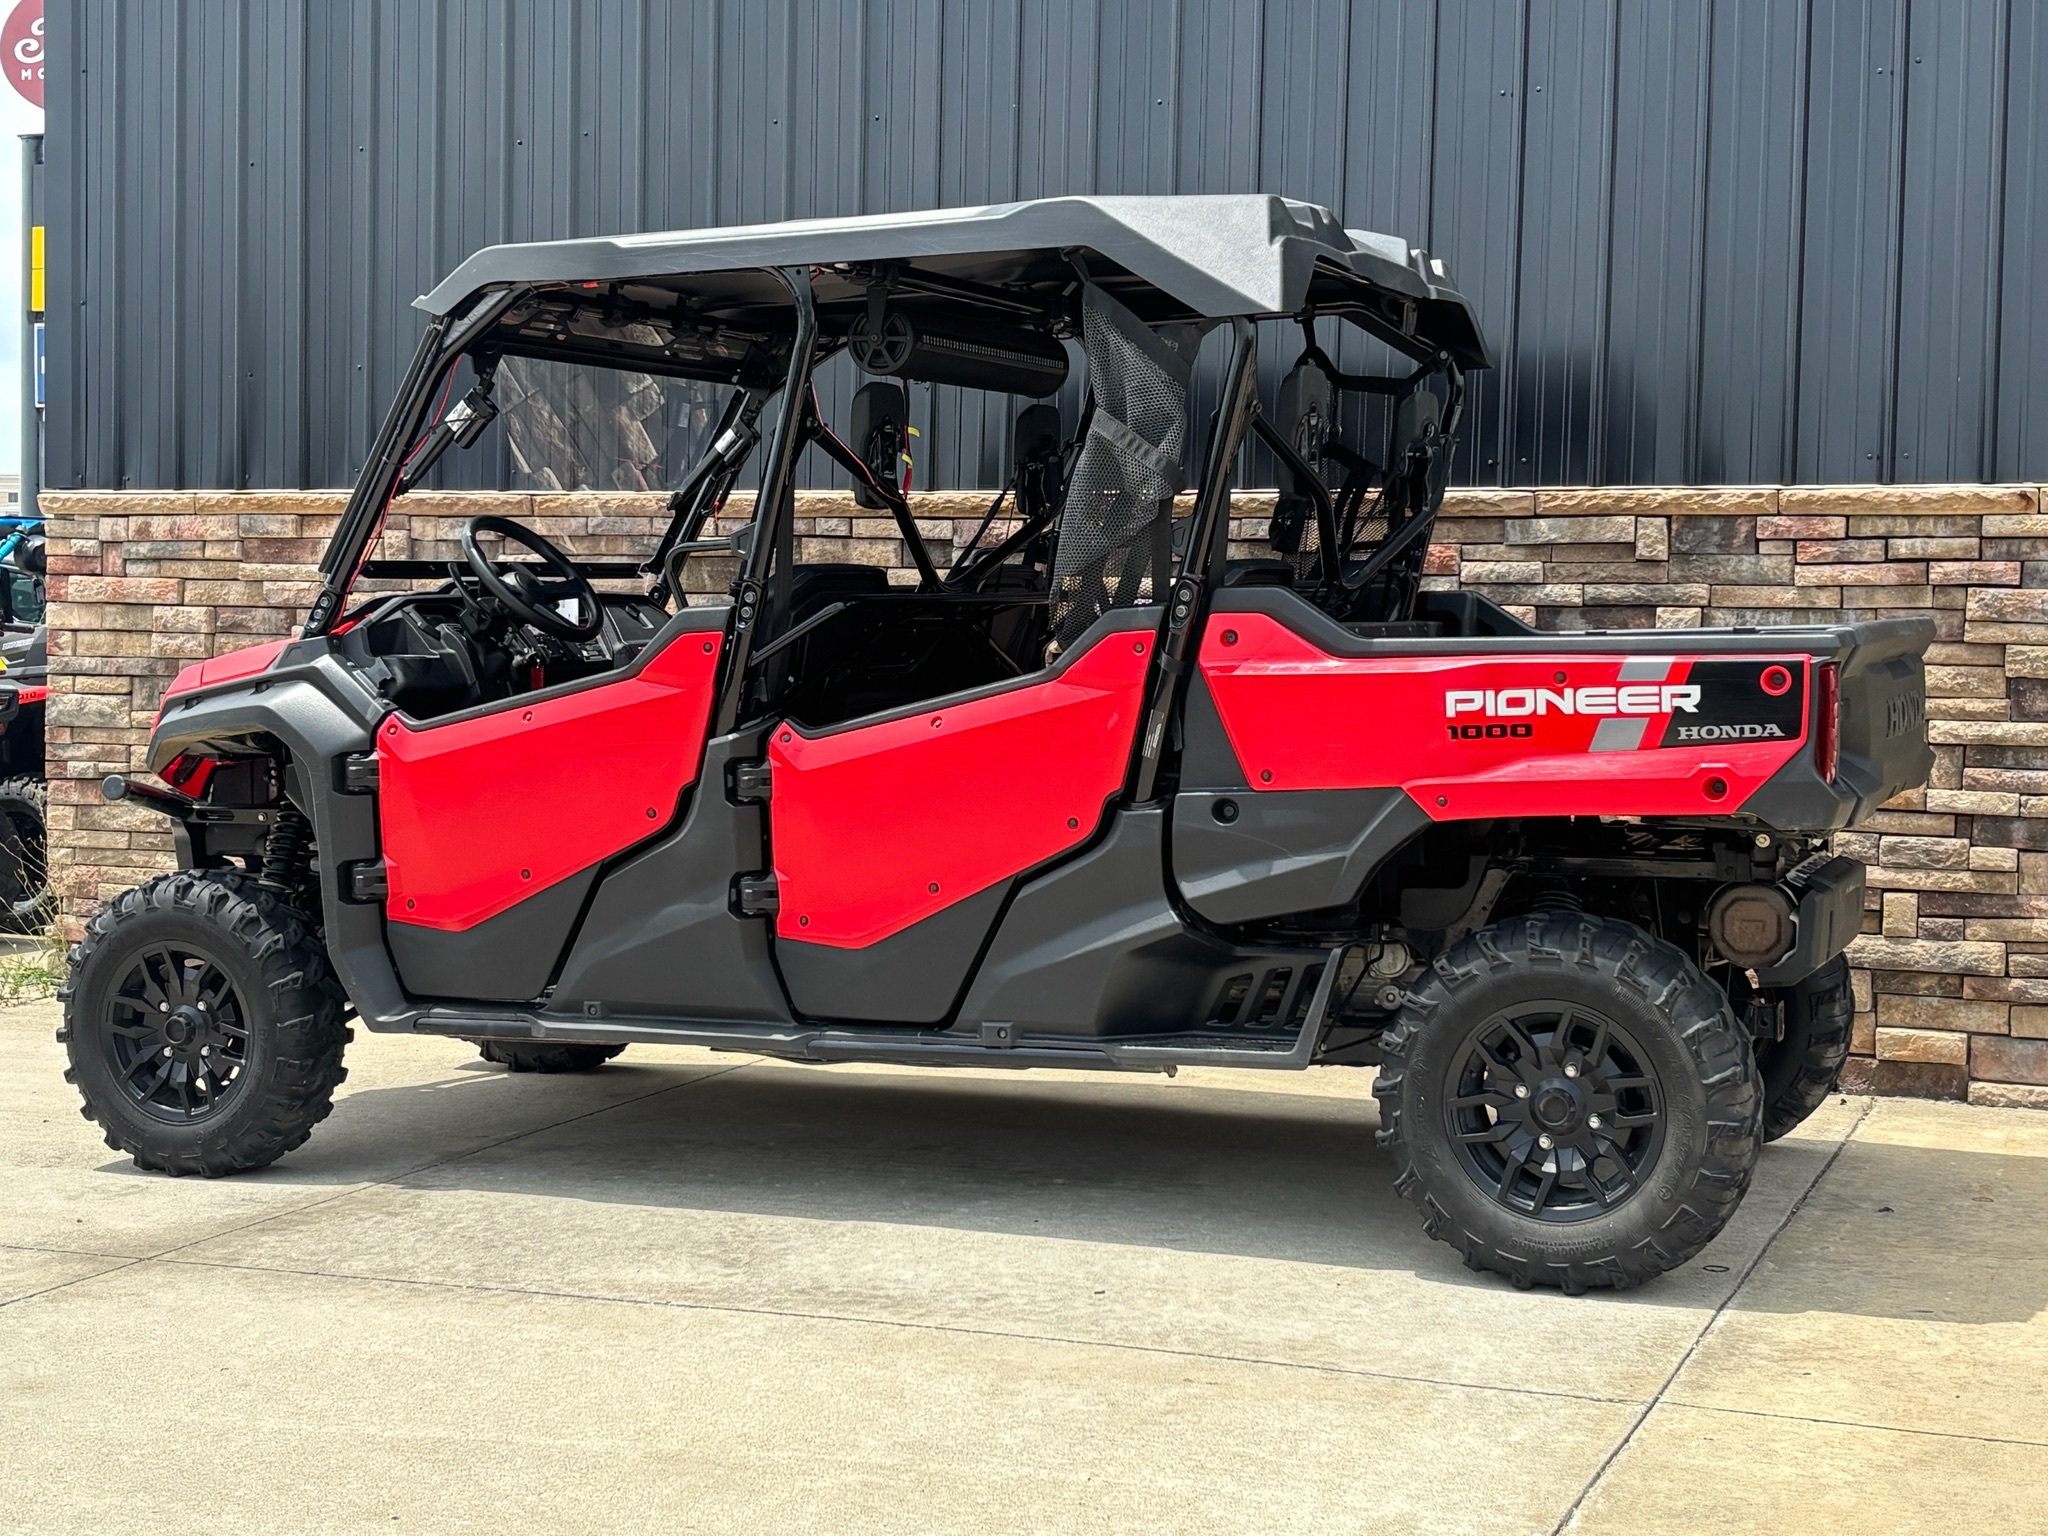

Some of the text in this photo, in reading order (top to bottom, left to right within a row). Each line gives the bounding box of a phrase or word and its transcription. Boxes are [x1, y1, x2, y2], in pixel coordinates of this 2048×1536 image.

[1445, 685, 1701, 718] PIONEER
[1446, 723, 1533, 740] 1000
[1677, 723, 1786, 740] HONDA
